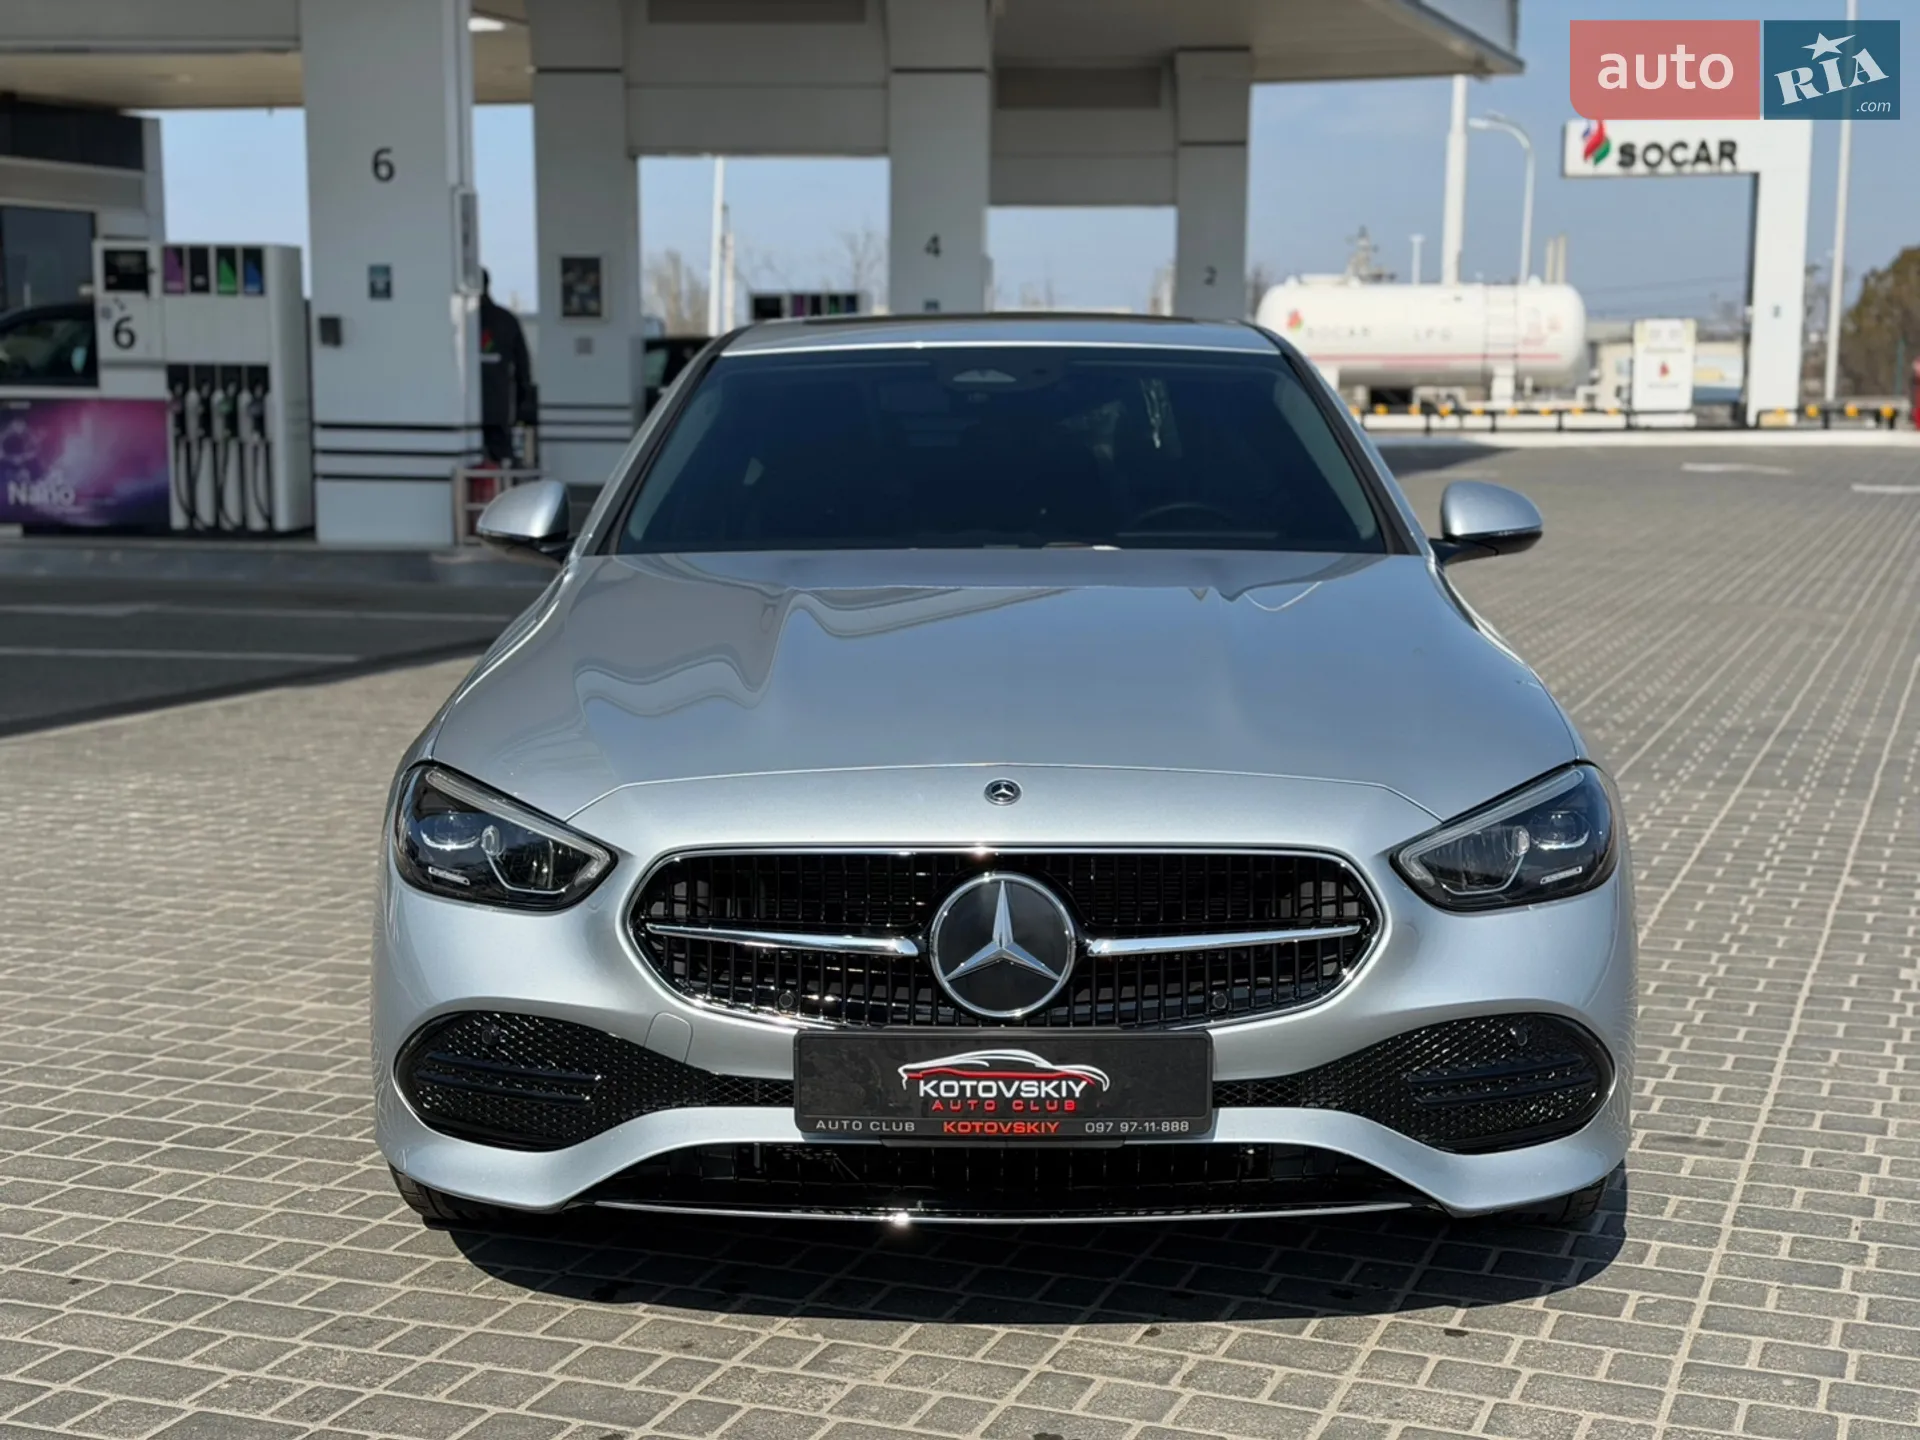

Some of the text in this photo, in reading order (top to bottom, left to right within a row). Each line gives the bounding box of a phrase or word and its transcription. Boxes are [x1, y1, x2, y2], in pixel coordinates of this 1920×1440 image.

[372, 147, 396, 183] 6
[1617, 140, 1738, 168] SOCAR
[924, 233, 942, 258] 4
[1203, 265, 1218, 286] 2
[113, 316, 136, 351] 6
[919, 1080, 1088, 1098] KOTOVSKIY
[931, 1100, 1078, 1112] AUTO CLUB
[815, 1120, 1189, 1134] AUTO CLUB KOTOVSKIY 097 97-11-888
